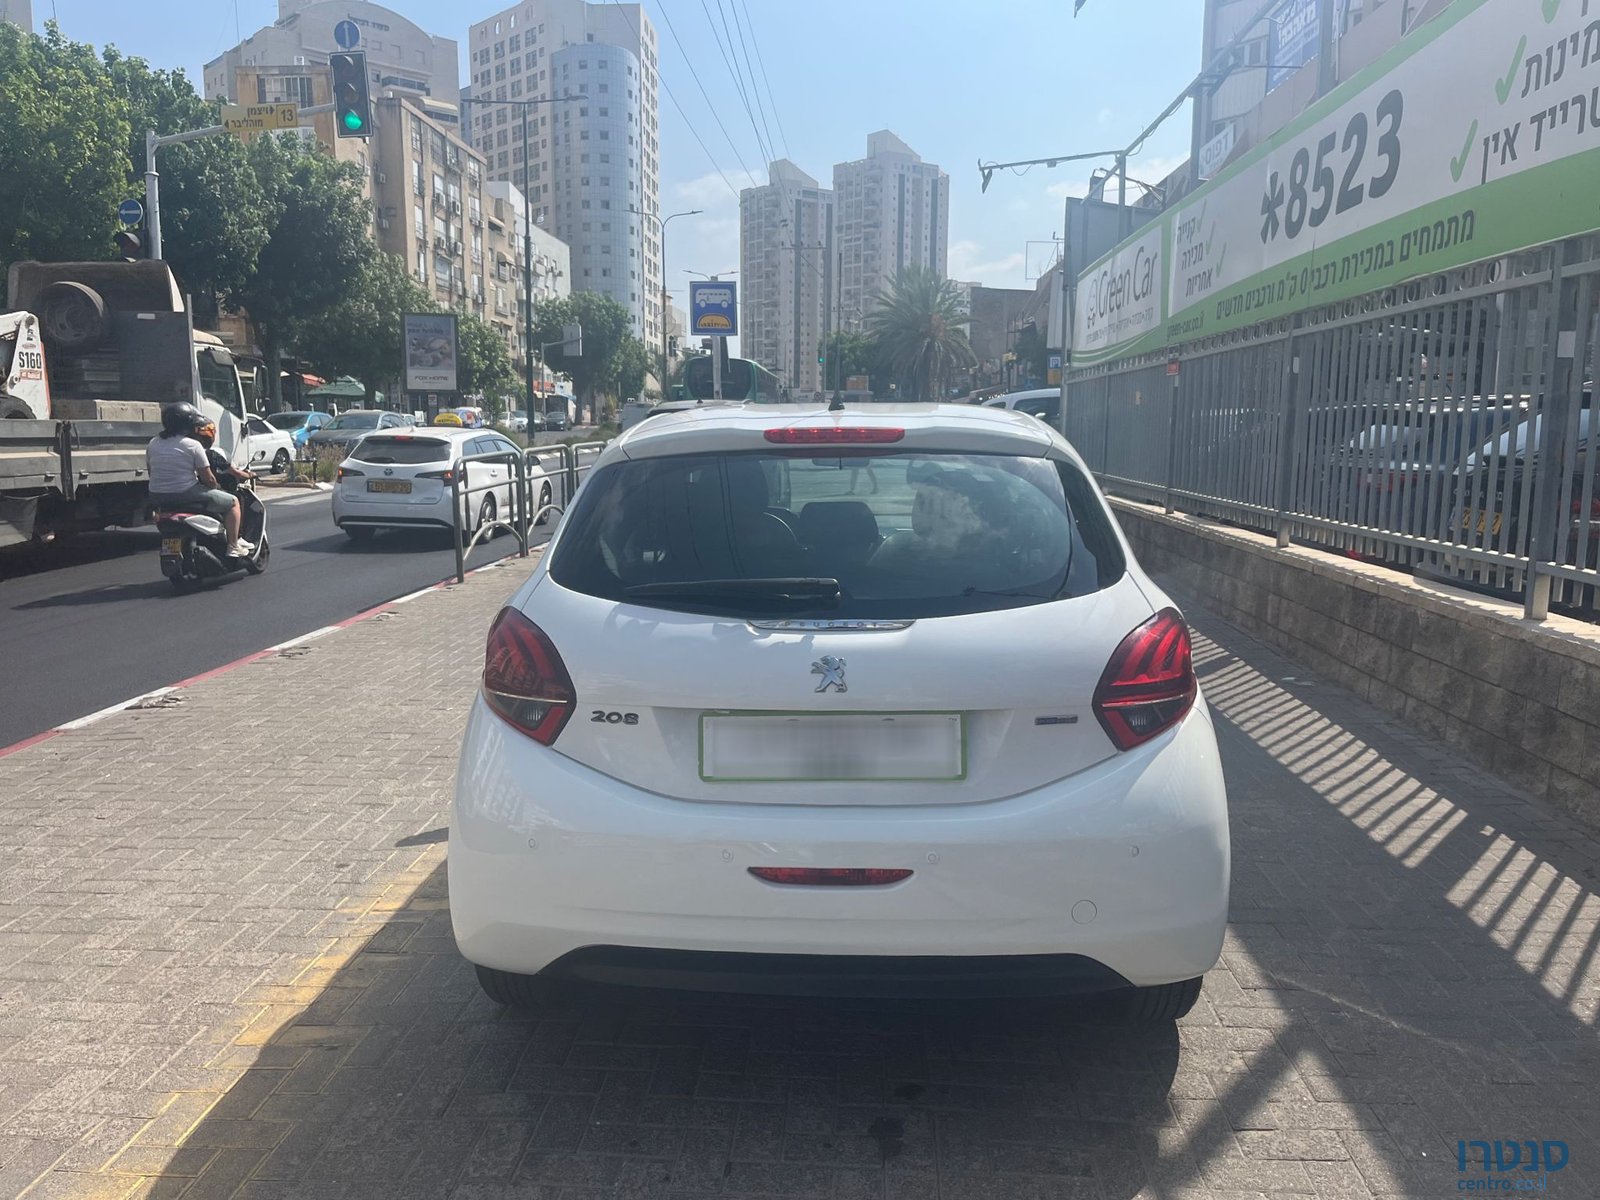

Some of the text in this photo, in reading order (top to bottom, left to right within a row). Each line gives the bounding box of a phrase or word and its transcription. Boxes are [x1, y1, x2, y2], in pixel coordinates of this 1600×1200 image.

[247, 106, 268, 118] ויצמן
[281, 109, 294, 122] 13
[1481, 122, 1521, 185] אין
[1177, 216, 1196, 245] קנייה
[1400, 209, 1475, 262] מתמחים
[1181, 242, 1204, 271] מכירה
[1338, 239, 1395, 283] במכירת
[1099, 245, 1158, 319] Green Car
[1186, 267, 1213, 298] אחריות
[18, 351, 42, 369] S160
[784, 620, 879, 629] PEUGEOT
[590, 710, 640, 726] 208
